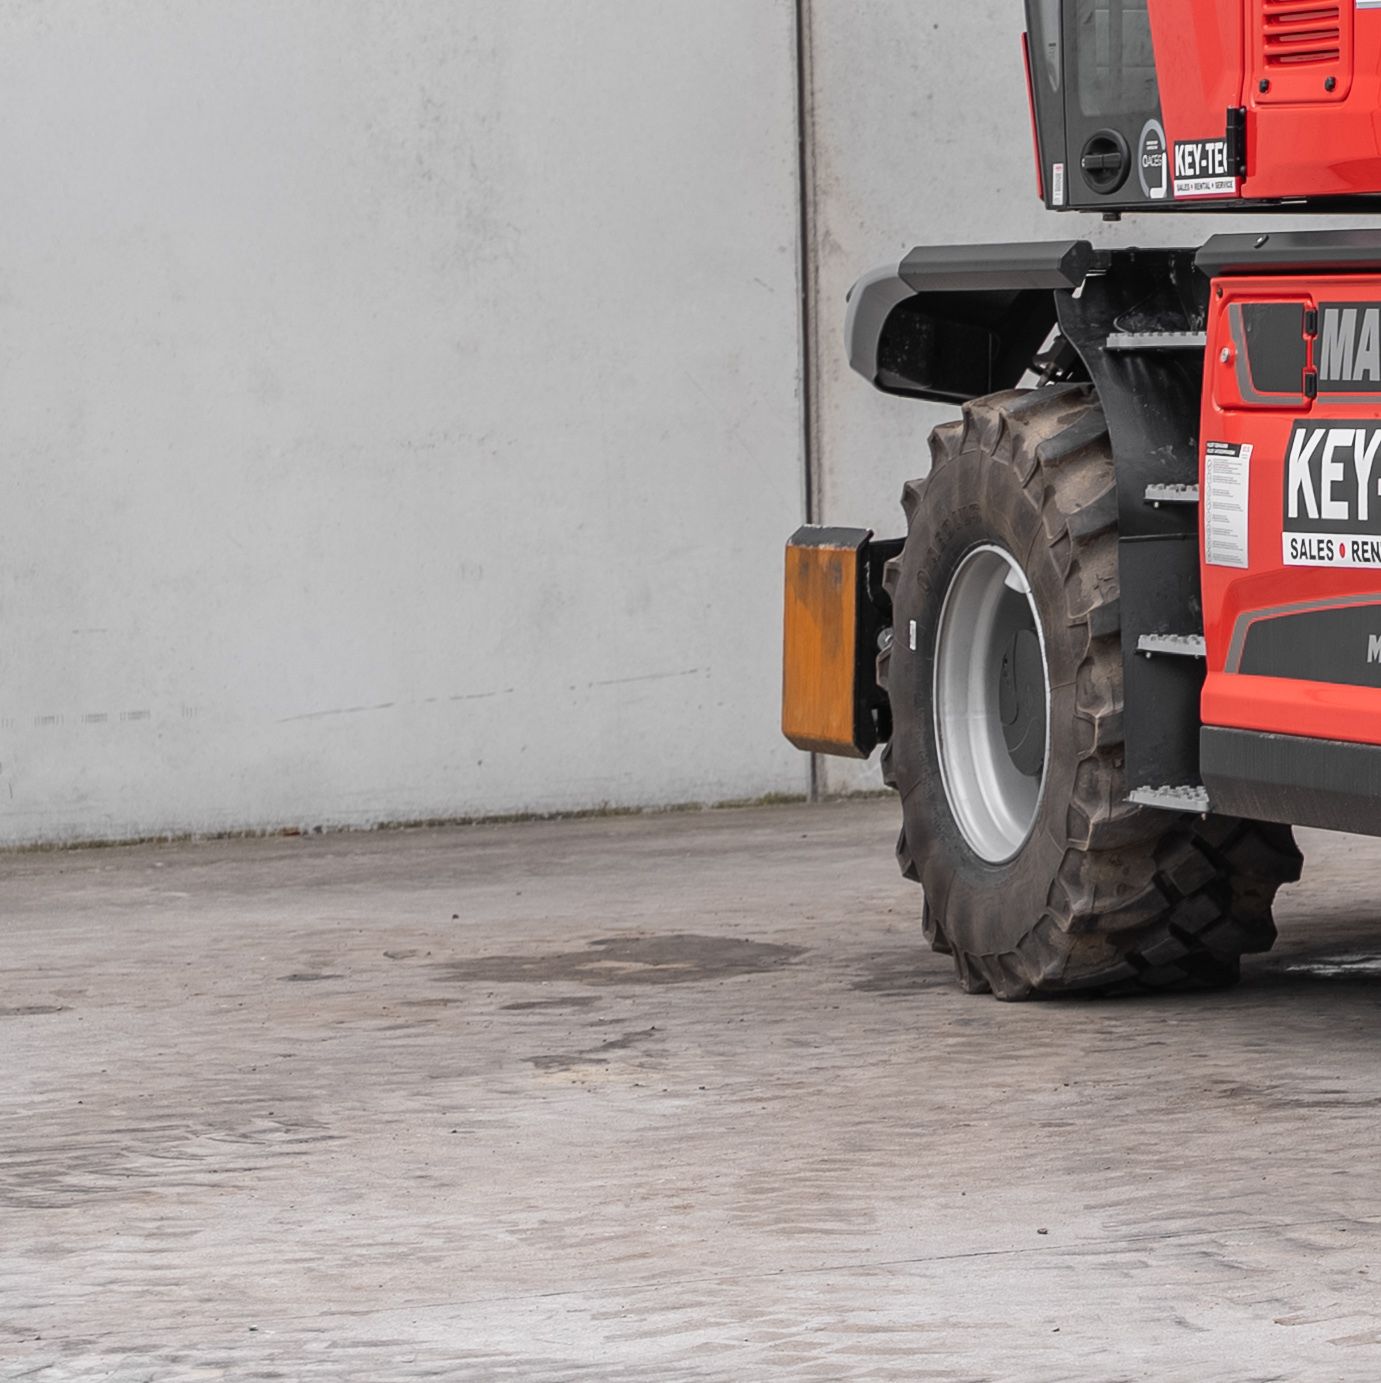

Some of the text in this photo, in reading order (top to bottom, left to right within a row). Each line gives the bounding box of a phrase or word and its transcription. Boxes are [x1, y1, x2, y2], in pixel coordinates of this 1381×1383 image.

[1177, 180, 1234, 192] SALES RENTAL SERVICE
[1290, 538, 1335, 561] SALES
